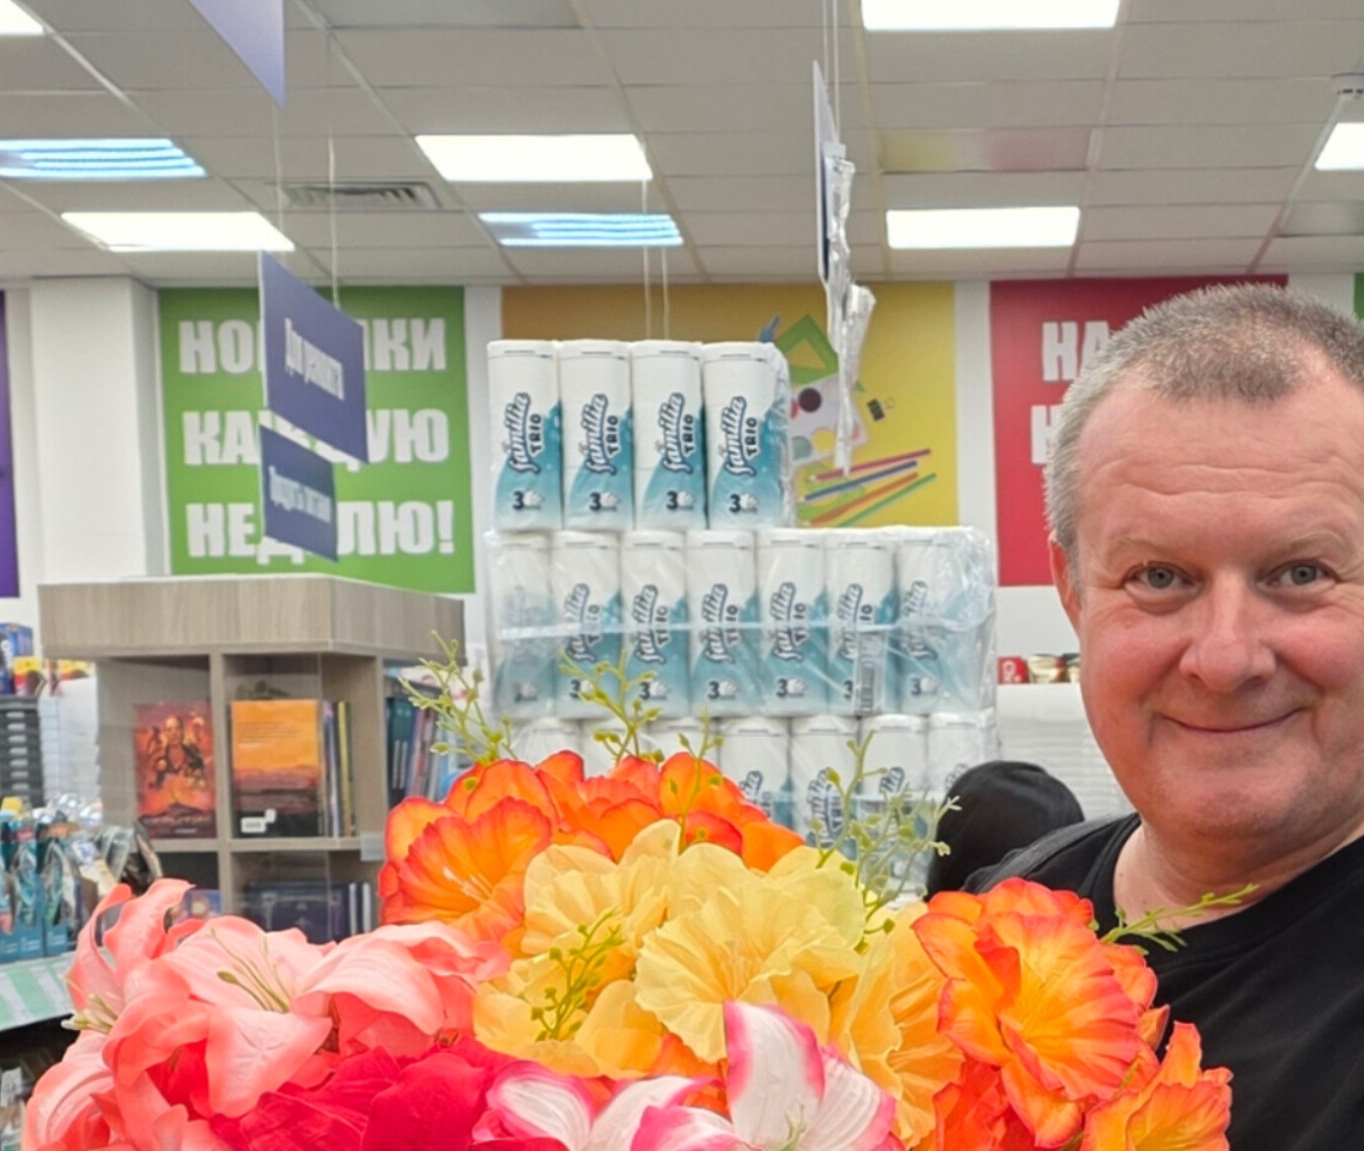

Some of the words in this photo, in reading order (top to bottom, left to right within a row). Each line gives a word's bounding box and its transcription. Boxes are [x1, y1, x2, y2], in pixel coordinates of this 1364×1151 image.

[178, 318, 446, 374] НОКИ
[182, 409, 450, 472] КАУЮ
[512, 491, 525, 511] 3
[589, 492, 601, 512] 3
[666, 490, 678, 510] 3
[729, 493, 742, 513] 3
[186, 500, 454, 564] НЕЛЮ!
[708, 680, 721, 700] 3
[776, 678, 788, 698] 3
